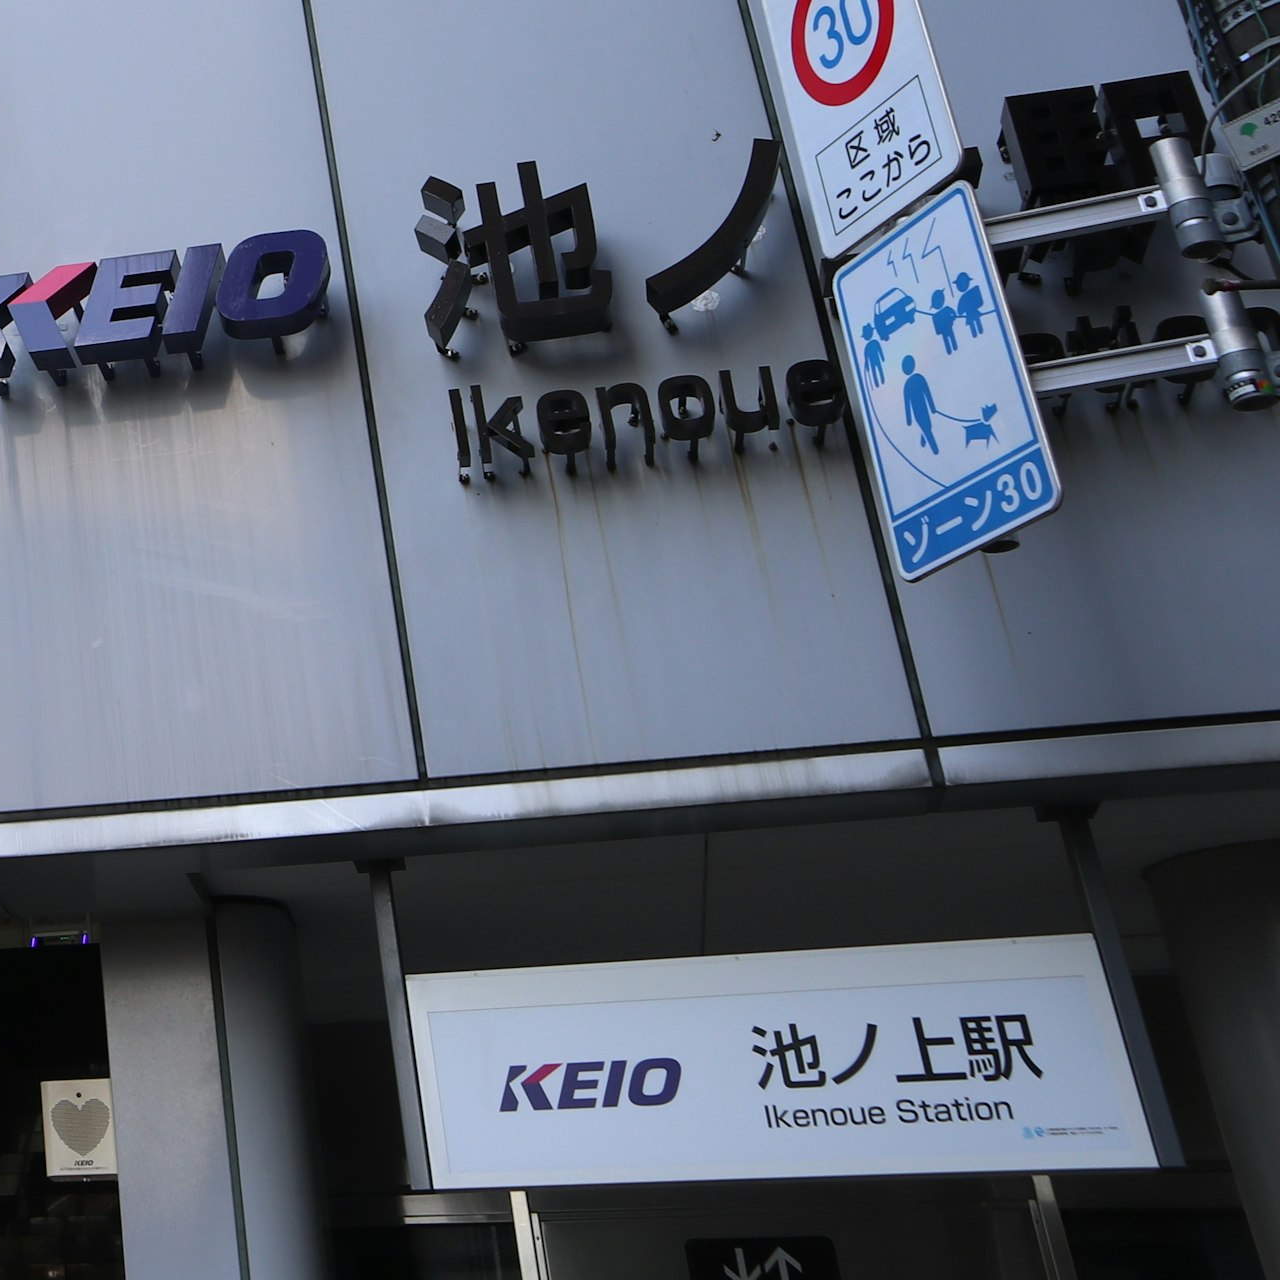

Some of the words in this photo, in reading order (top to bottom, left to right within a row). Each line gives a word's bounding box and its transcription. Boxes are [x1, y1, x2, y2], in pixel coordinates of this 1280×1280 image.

[845, 107, 900, 169] 区域
[835, 133, 932, 220] ここから
[448, 358, 847, 472] Ikenoue
[902, 461, 1043, 563] ゾーン30
[499, 1057, 682, 1112] KEIO
[751, 1013, 1044, 1090] 池ノ上駅
[763, 1103, 886, 1129] Ikenoue
[895, 1096, 1015, 1124] Station
[74, 1159, 94, 1167] KEIO
